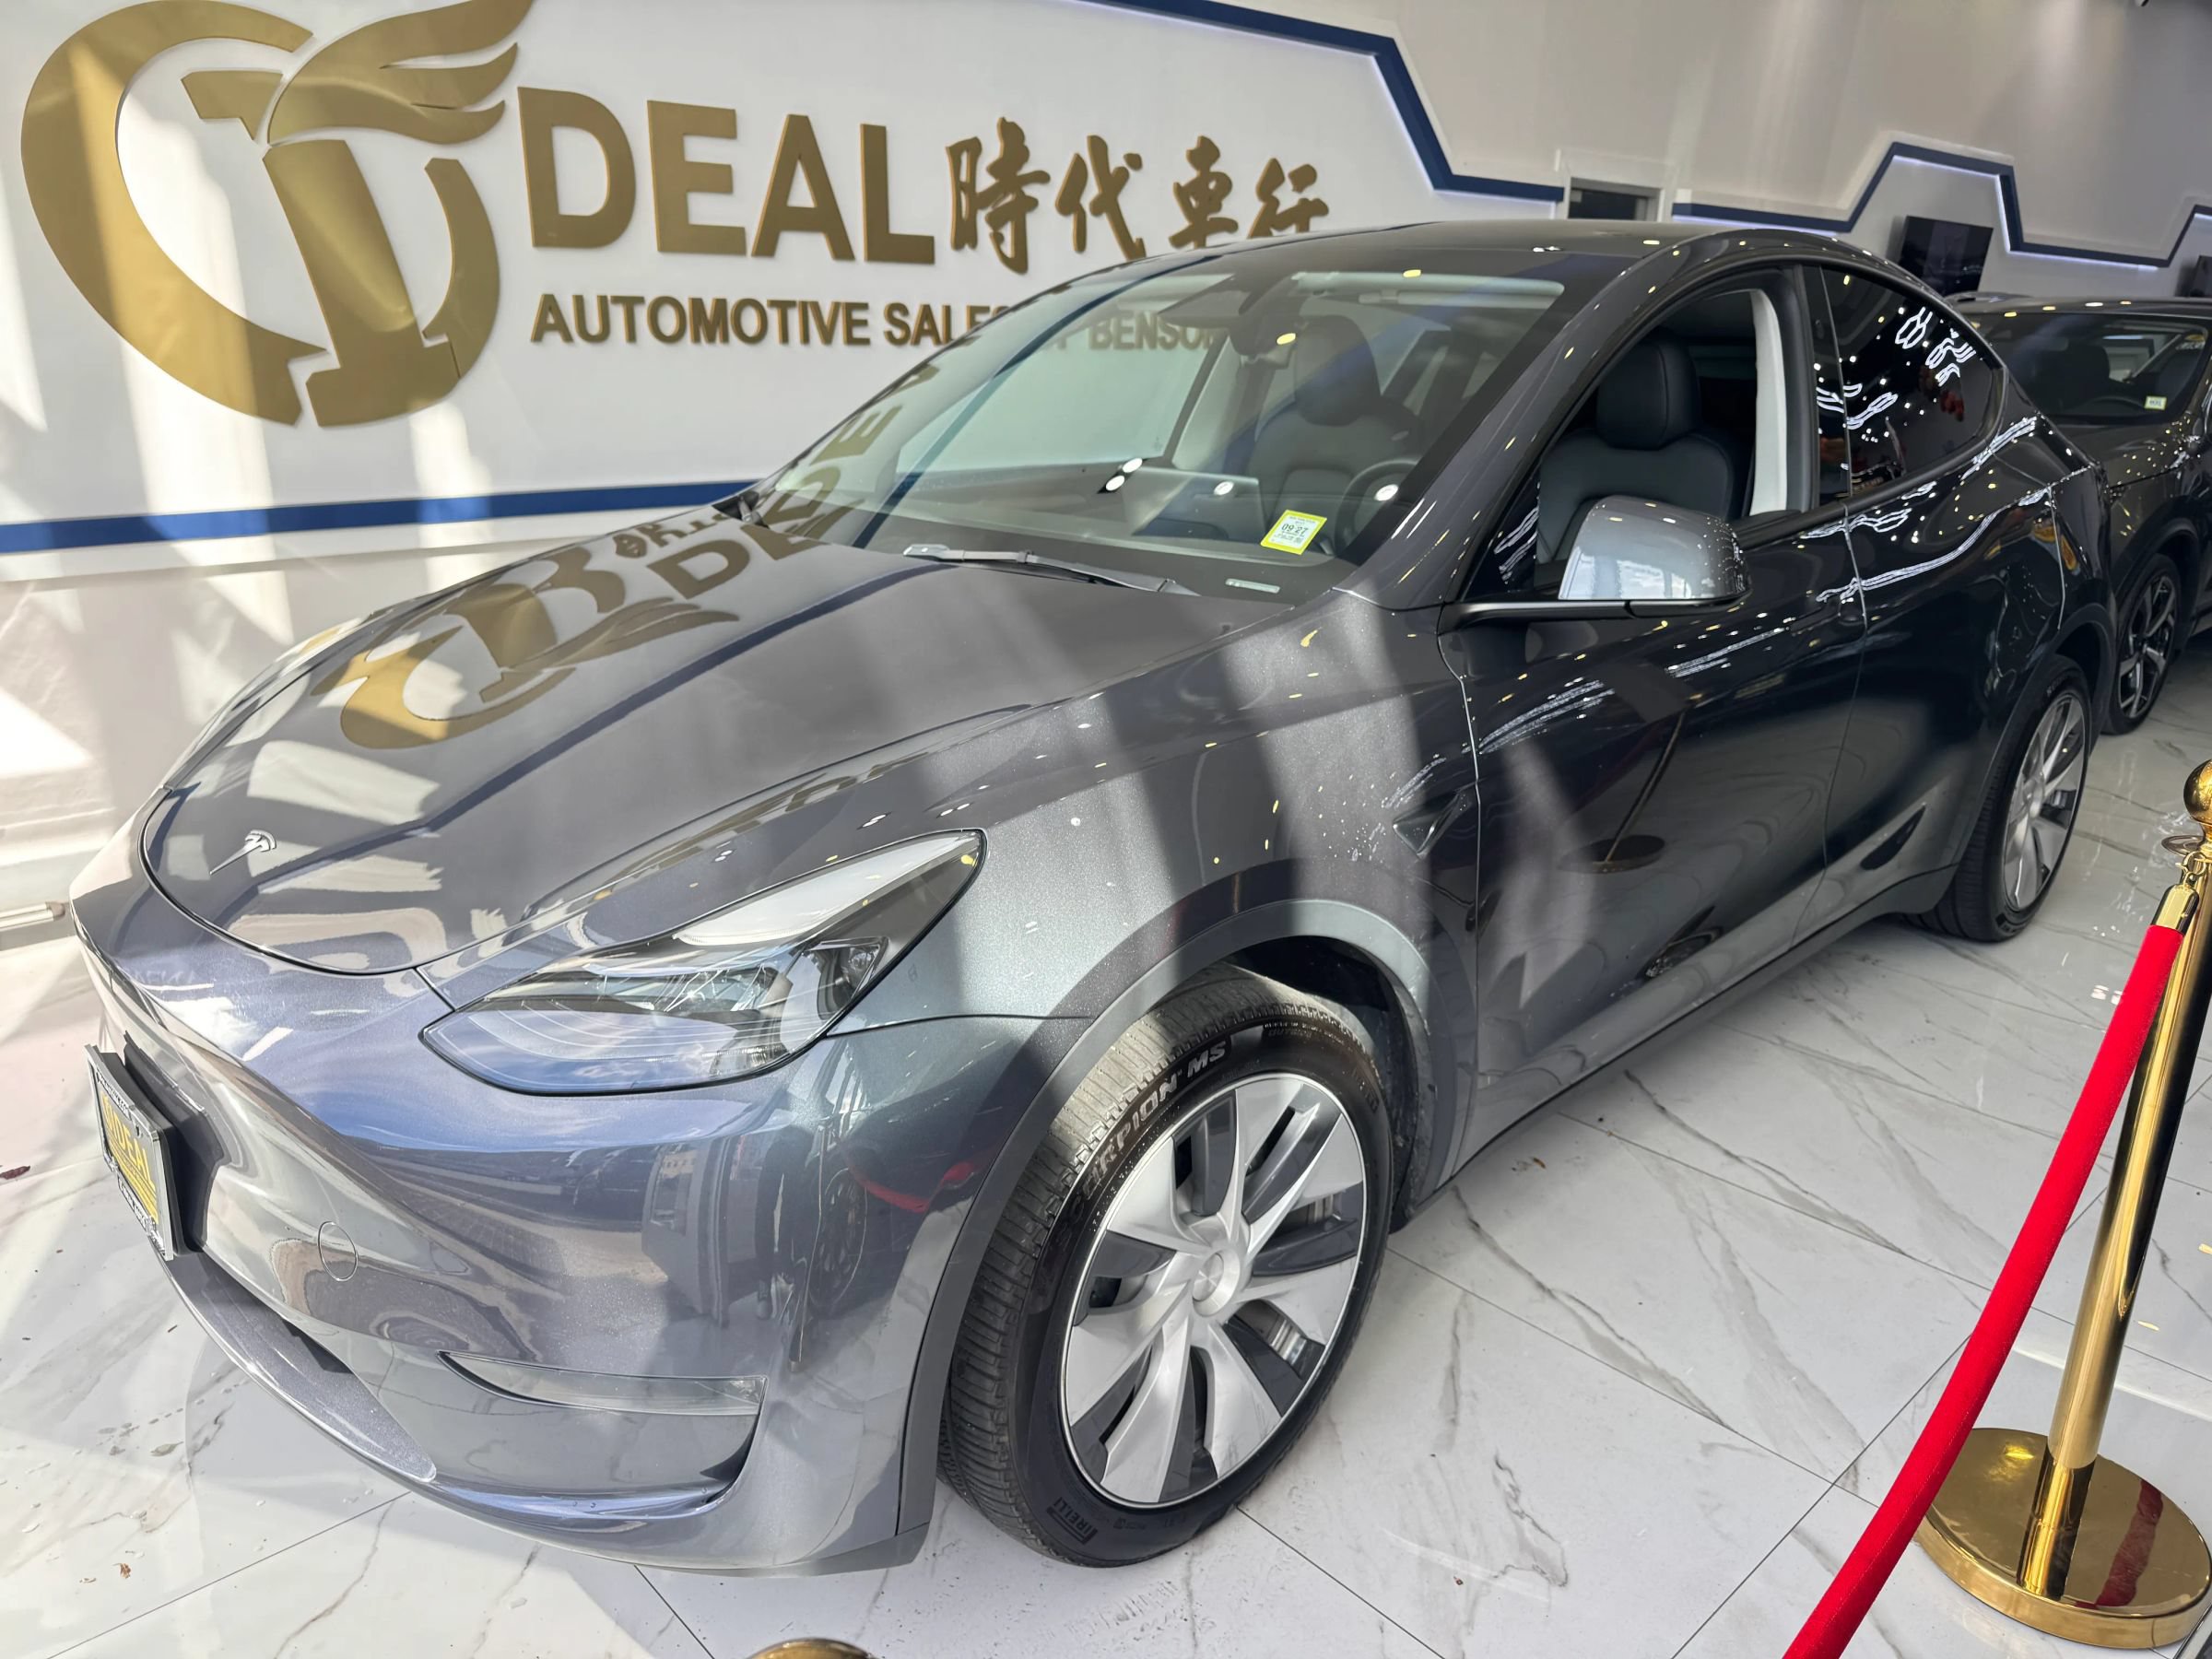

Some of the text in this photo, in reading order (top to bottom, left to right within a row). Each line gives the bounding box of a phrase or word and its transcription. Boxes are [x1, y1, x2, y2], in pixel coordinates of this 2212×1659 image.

[517, 87, 935, 265] DEAL
[530, 293, 871, 345] AUTOMOTIVE
[1187, 1040, 1227, 1078] MS
